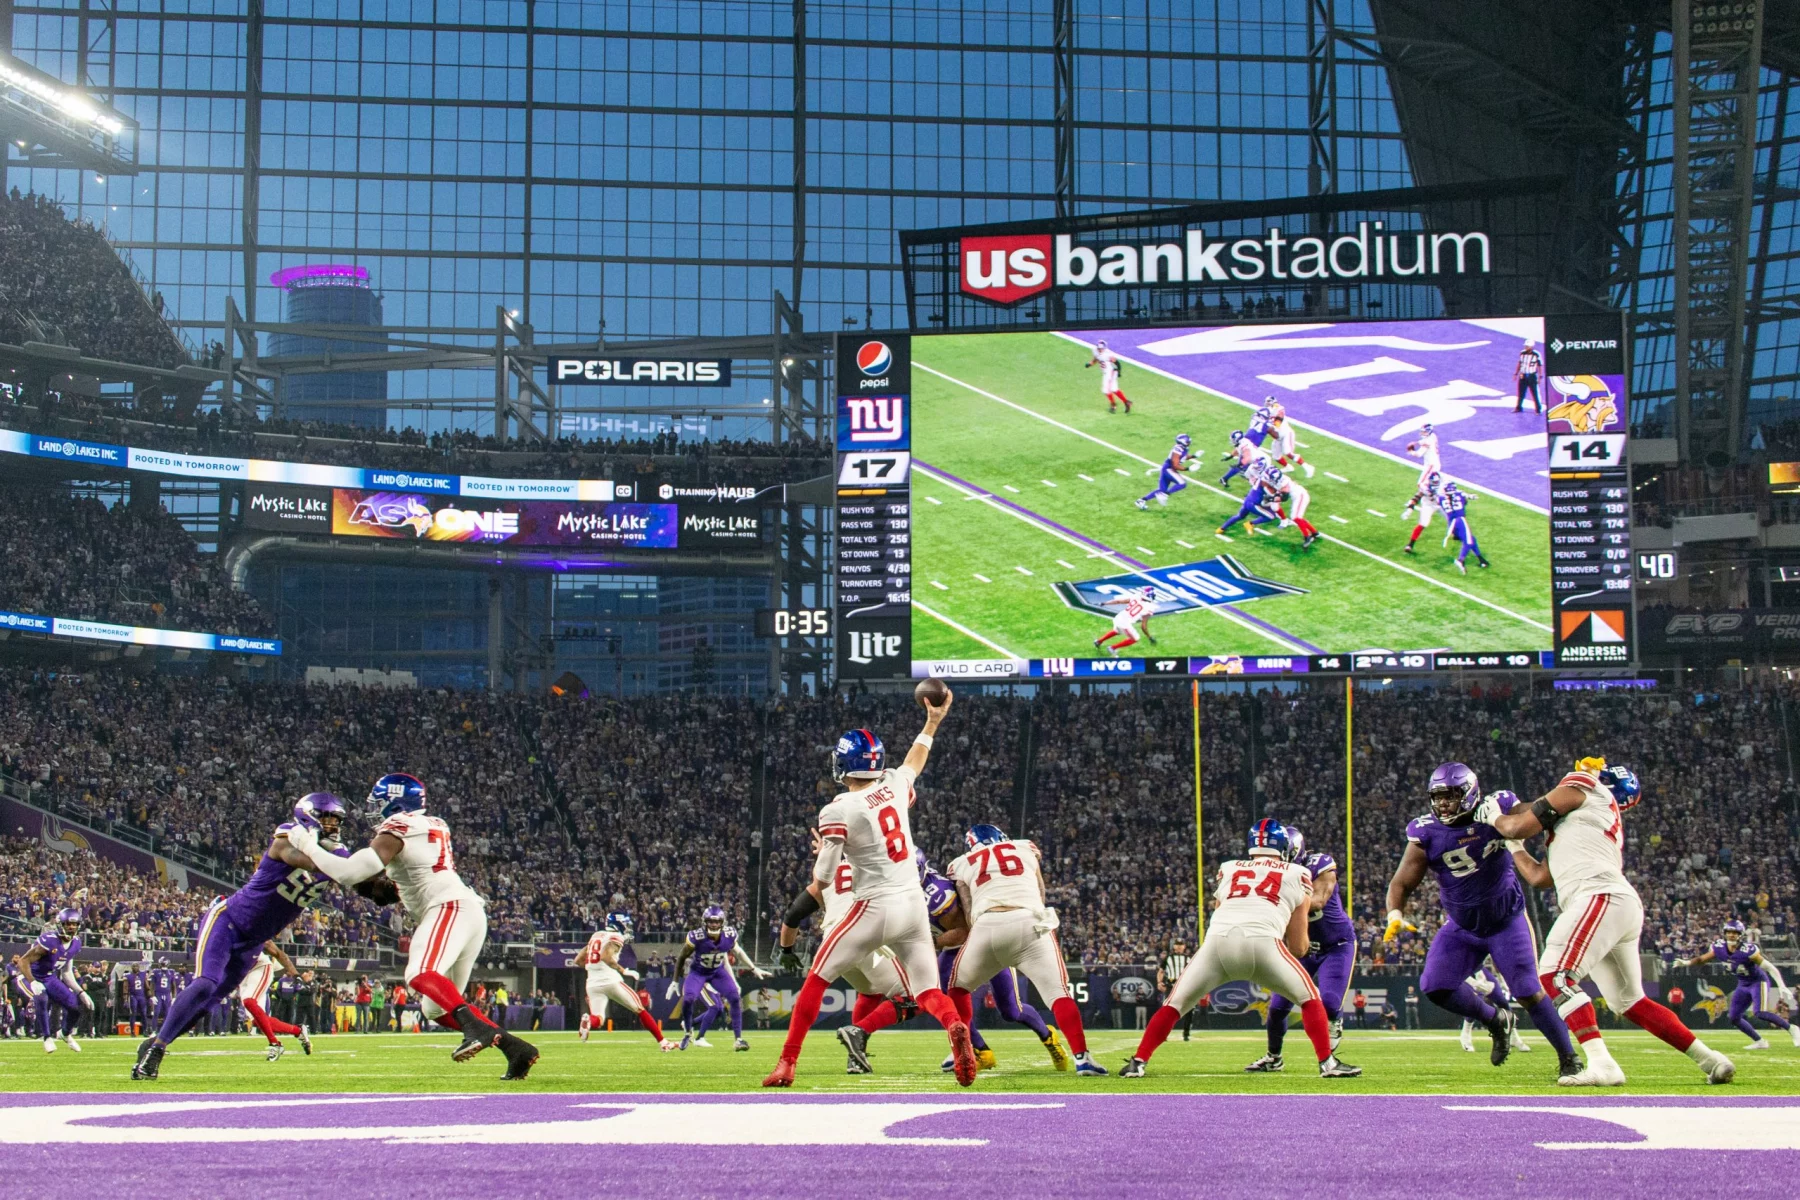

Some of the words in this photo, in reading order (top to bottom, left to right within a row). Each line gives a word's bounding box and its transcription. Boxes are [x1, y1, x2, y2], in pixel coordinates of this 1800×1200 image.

[1566, 340, 1617, 350] PENTAIR
[558, 360, 720, 382] POLARIS
[860, 377, 889, 389] pepsi
[39, 441, 62, 453] LAND
[1563, 441, 1610, 460] 14
[135, 455, 171, 466] ROOTED
[173, 459, 182, 468] IN
[852, 459, 897, 478] 17
[373, 474, 395, 485] LAND
[467, 482, 503, 492] ROOTED
[617, 487, 630, 495] CC
[674, 488, 717, 496] TRAINING
[717, 487, 756, 498] HAUS
[1607, 489, 1622, 498] 44
[841, 507, 859, 515] RUSH
[890, 505, 907, 514] 126
[435, 508, 519, 533] ONE
[841, 521, 859, 529] PASS
[860, 521, 873, 529] YDS
[890, 520, 908, 529] 130
[1606, 519, 1624, 528] 174
[841, 536, 863, 544] TOTAL
[890, 535, 908, 543] 256
[1610, 534, 1622, 543] 12
[893, 549, 905, 558] 13
[1554, 551, 1587, 559] PEN/YDS
[841, 565, 871, 573] PEN/YDS
[888, 564, 910, 573] 4/30
[1555, 566, 1599, 574] TURNOVERS
[1641, 554, 1674, 578] 40
[841, 580, 882, 588] TURNOVERS
[58, 623, 84, 632] ROOTED
[775, 610, 828, 635] 0:35
[221, 638, 237, 648] LAND
[848, 631, 902, 664] Lite
[1561, 646, 1627, 657] ANDERSEN
[1091, 660, 1132, 671] NYG
[1156, 660, 1177, 670] 17
[1257, 658, 1292, 669] MIN
[1318, 658, 1340, 669] 14
[1386, 656, 1397, 666] &
[1400, 655, 1425, 667] 10
[1437, 656, 1475, 666] BALL
[1478, 656, 1499, 665] ON
[1507, 655, 1529, 666] 10
[934, 664, 972, 673] WILD
[975, 663, 1014, 673] CARD
[870, 760, 877, 769] 8
[864, 786, 895, 810] JONES
[878, 805, 909, 863] 8
[967, 843, 1025, 887] 76
[1236, 859, 1290, 871] GLOWINSKI
[1227, 870, 1283, 906] 64
[135, 980, 142, 990] 2
